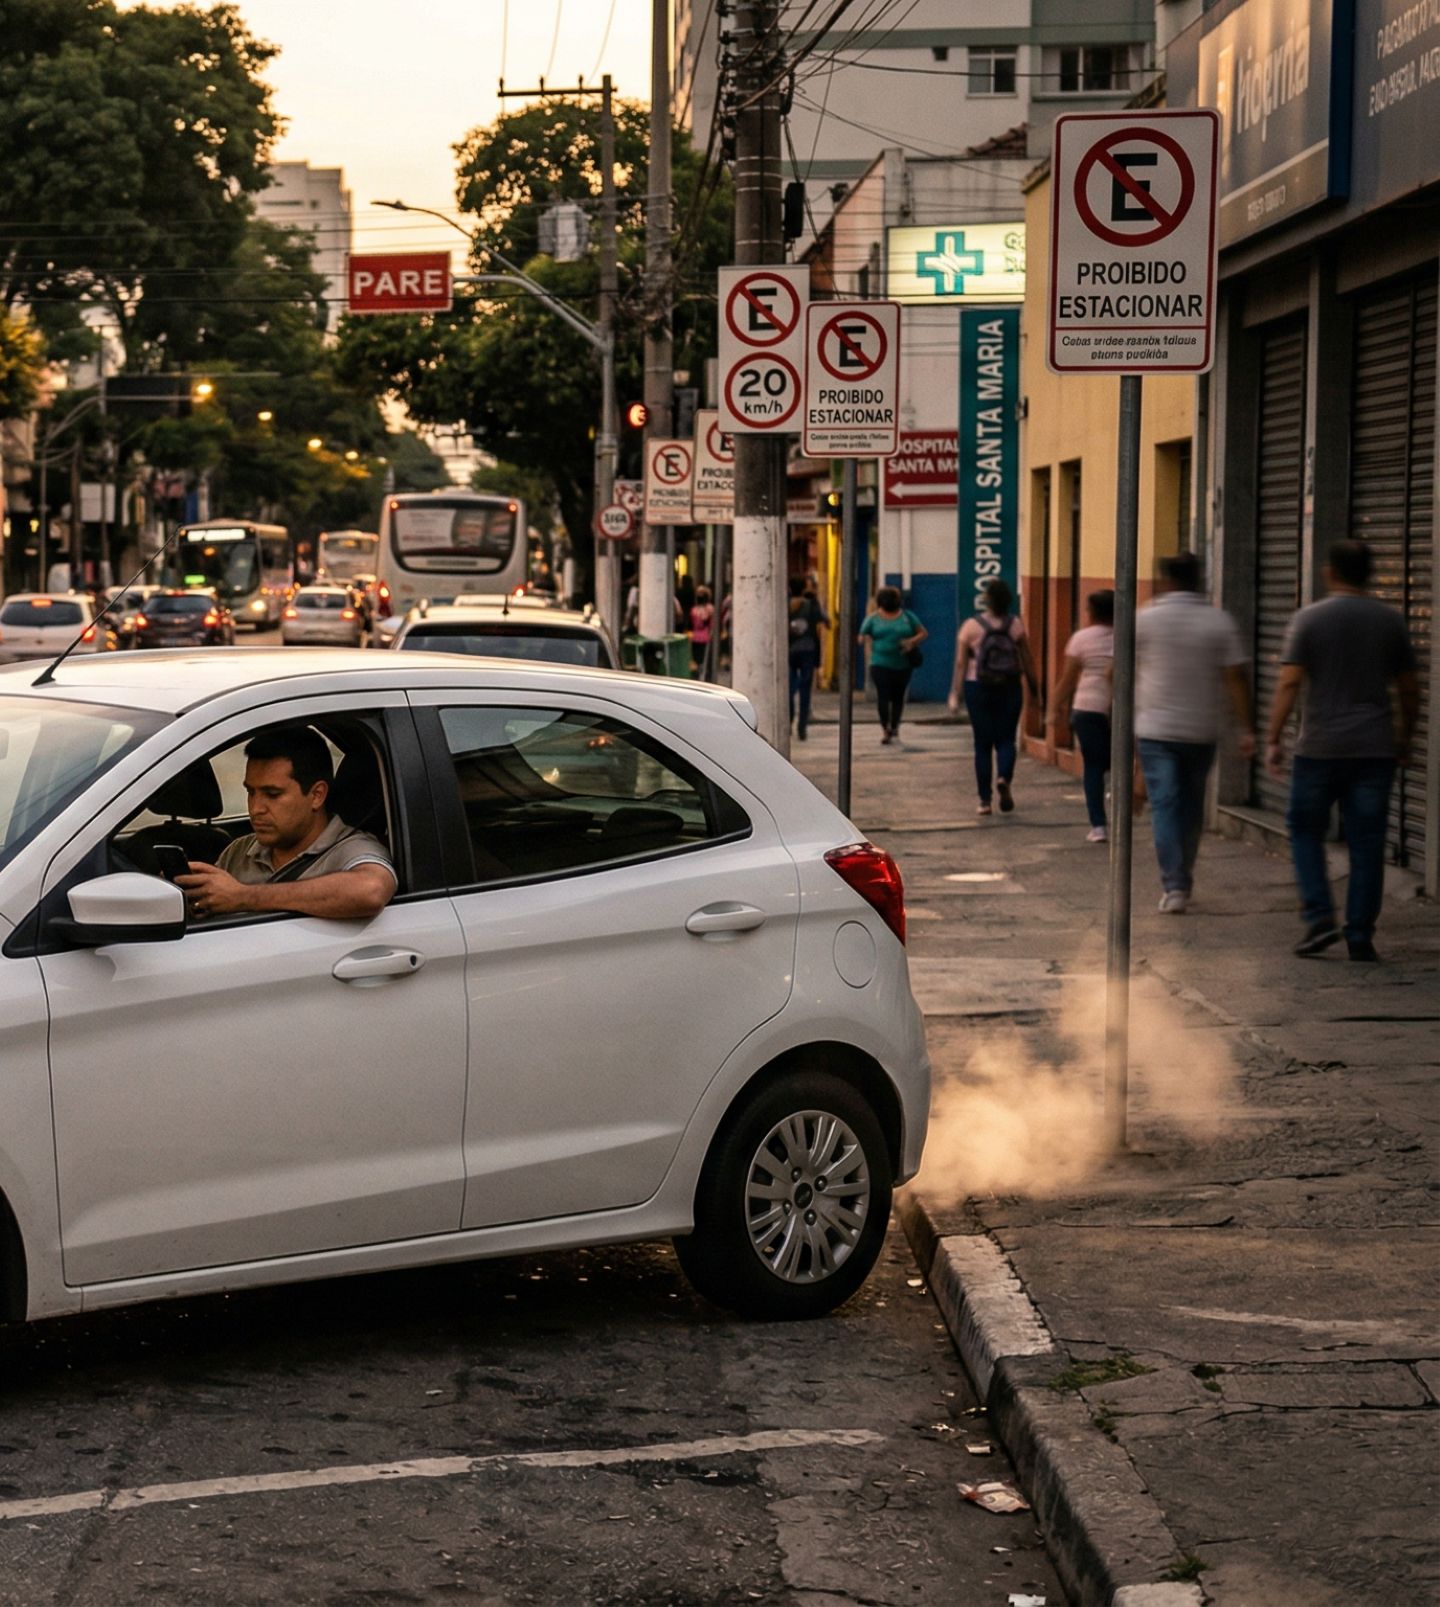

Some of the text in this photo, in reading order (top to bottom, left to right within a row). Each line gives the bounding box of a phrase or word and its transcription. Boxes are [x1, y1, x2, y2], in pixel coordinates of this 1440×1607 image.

[353, 269, 444, 295] PARE
[1077, 261, 1187, 285] PROIBIDO
[1059, 294, 1203, 318] ESTACIONAR
[976, 319, 1004, 400] MARIA
[739, 368, 787, 397] 20
[744, 400, 783, 415] km/h
[819, 389, 884, 404] PROIBIDO
[809, 409, 893, 423] ESTACIONAR
[976, 406, 1003, 487] SANTA
[888, 458, 935, 474] SANTA
